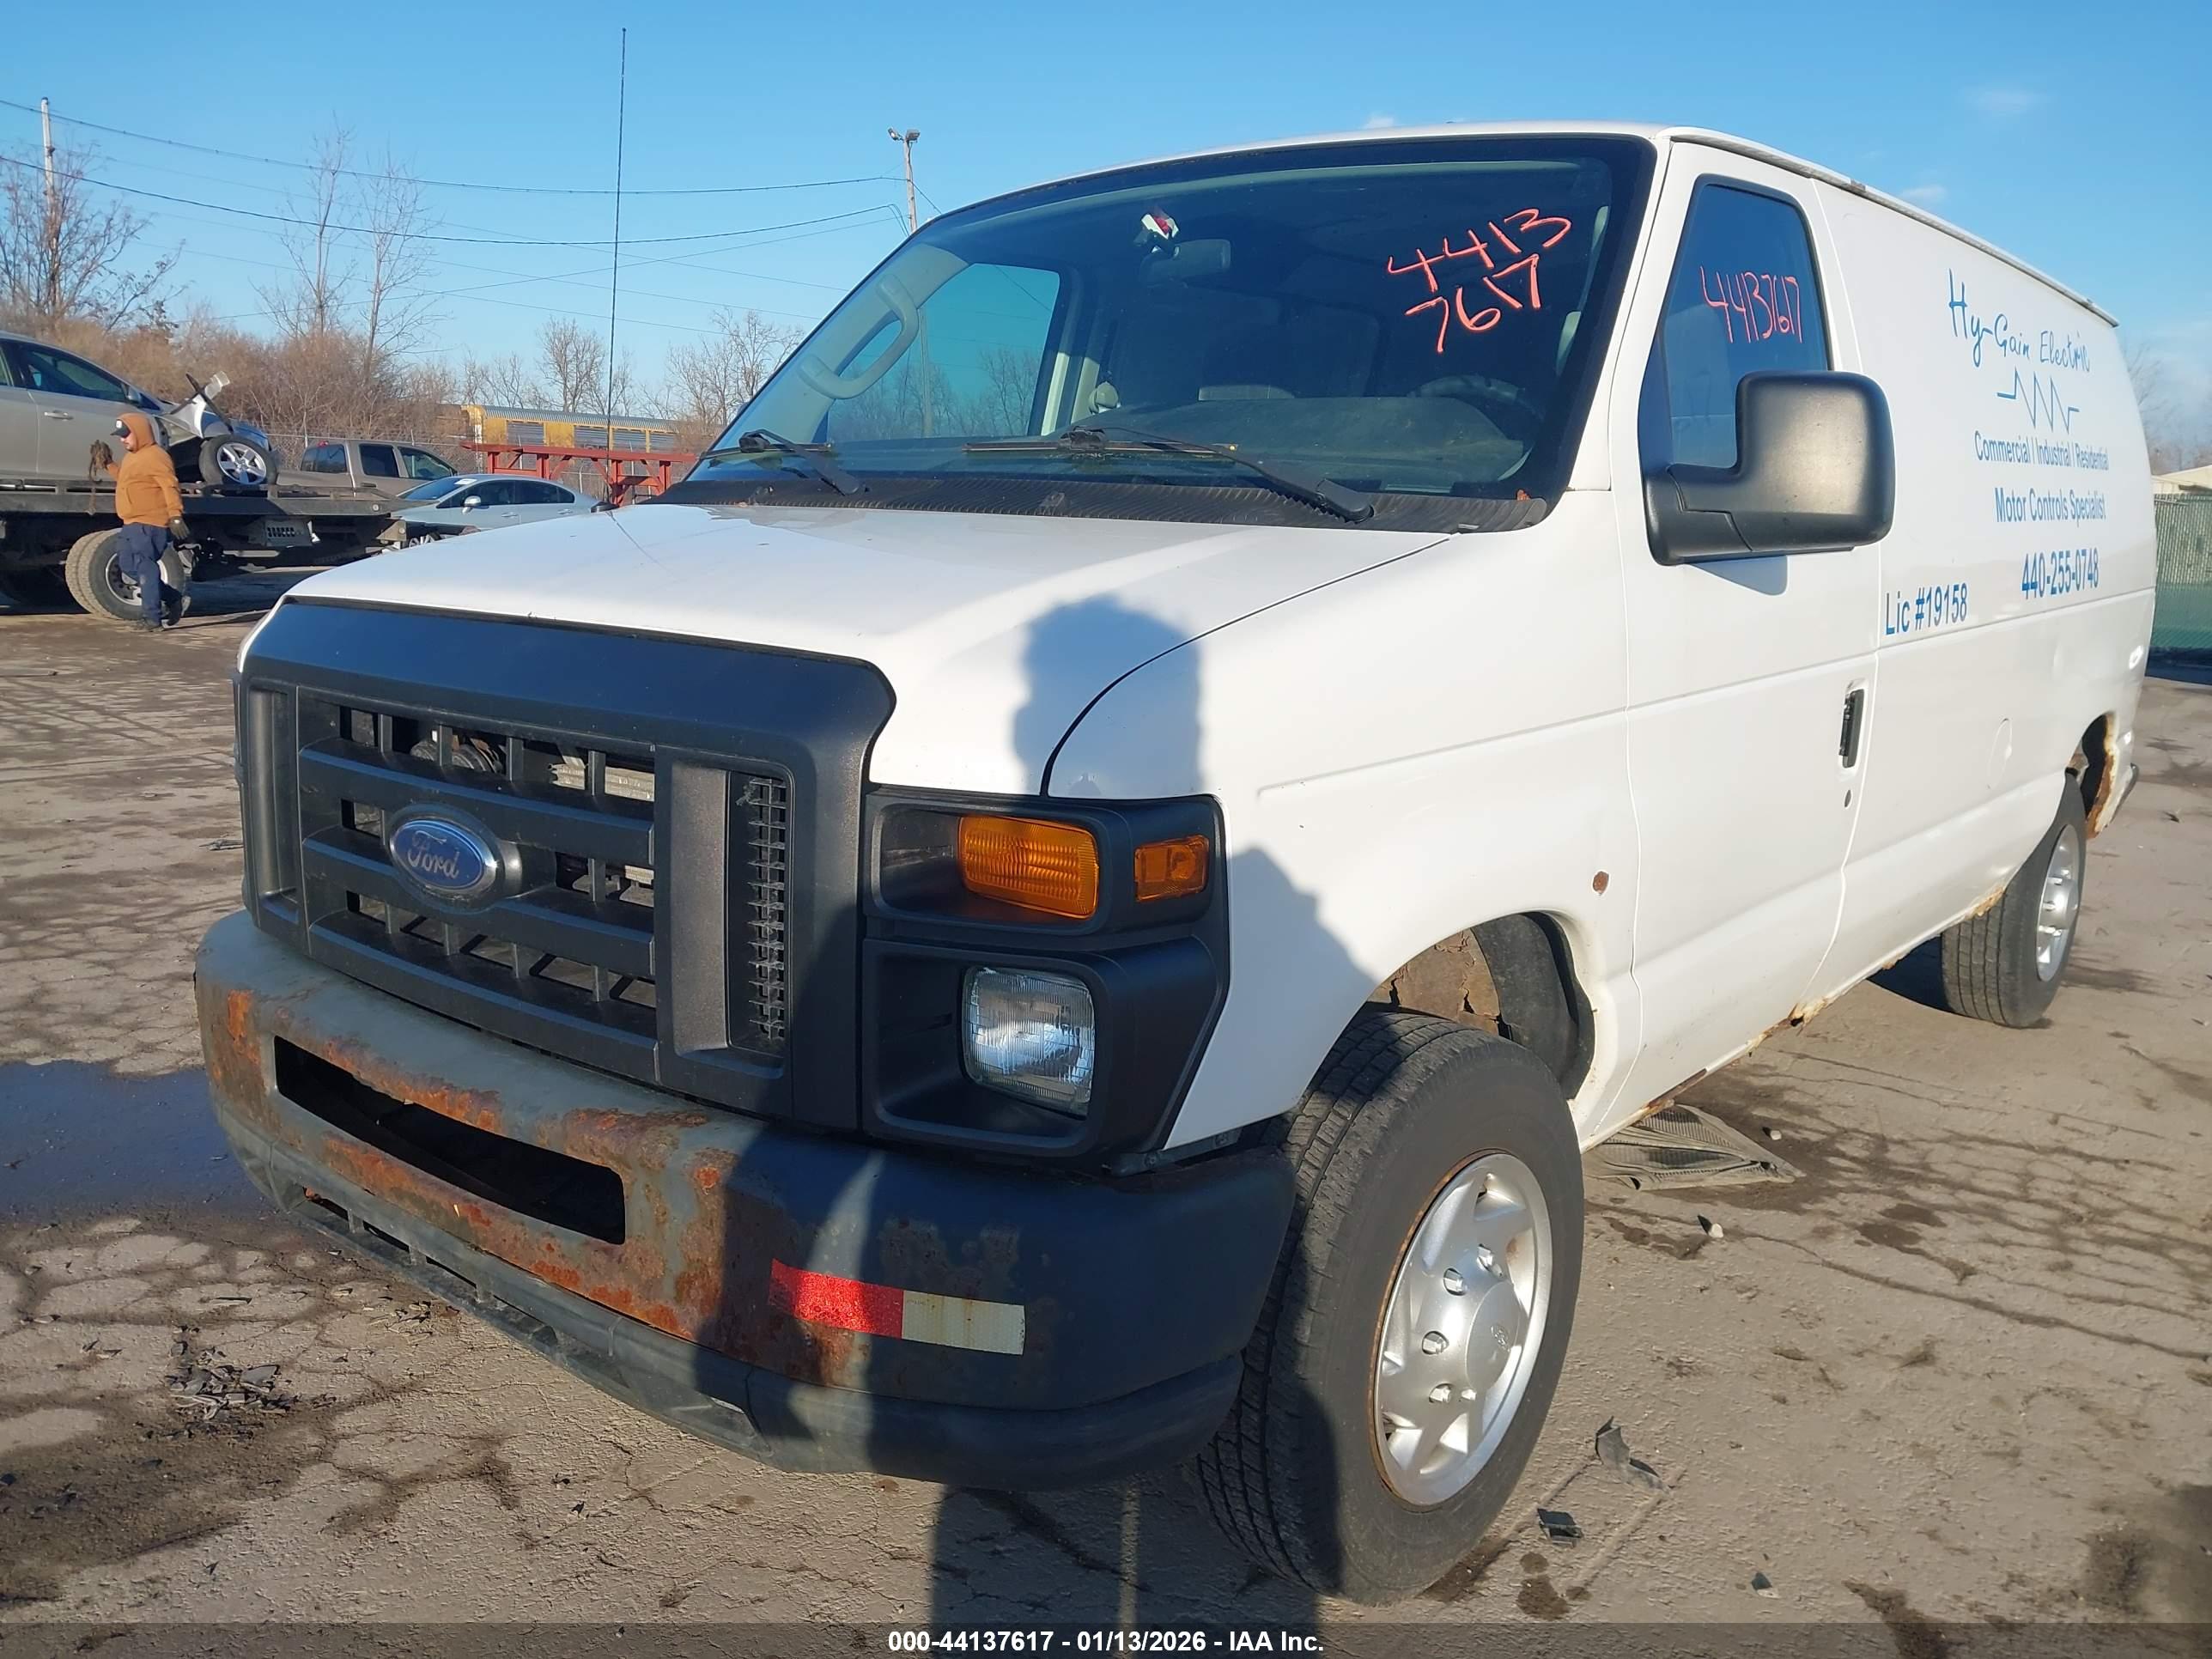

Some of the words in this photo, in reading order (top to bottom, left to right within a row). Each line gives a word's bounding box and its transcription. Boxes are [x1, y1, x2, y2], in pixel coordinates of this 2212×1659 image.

[1388, 209, 1571, 293] 4413
[1405, 253, 1541, 353] 7617
[1699, 265, 1802, 343] 44137617
[1948, 268, 2030, 368] Hy-Gain
[2040, 330, 2090, 372] Electric
[1974, 430, 2030, 464] Commercial
[2035, 436, 2071, 467] Industrial
[2075, 442, 2109, 471] Residential
[1995, 487, 2027, 523] Motor
[2029, 487, 2069, 522] Controls
[2069, 489, 2106, 528] Specialist
[2021, 547, 2100, 599] 440-255-0748
[1886, 591, 1910, 635] Lic
[1915, 582, 1968, 630] #19158
[408, 830, 459, 880] Ford
